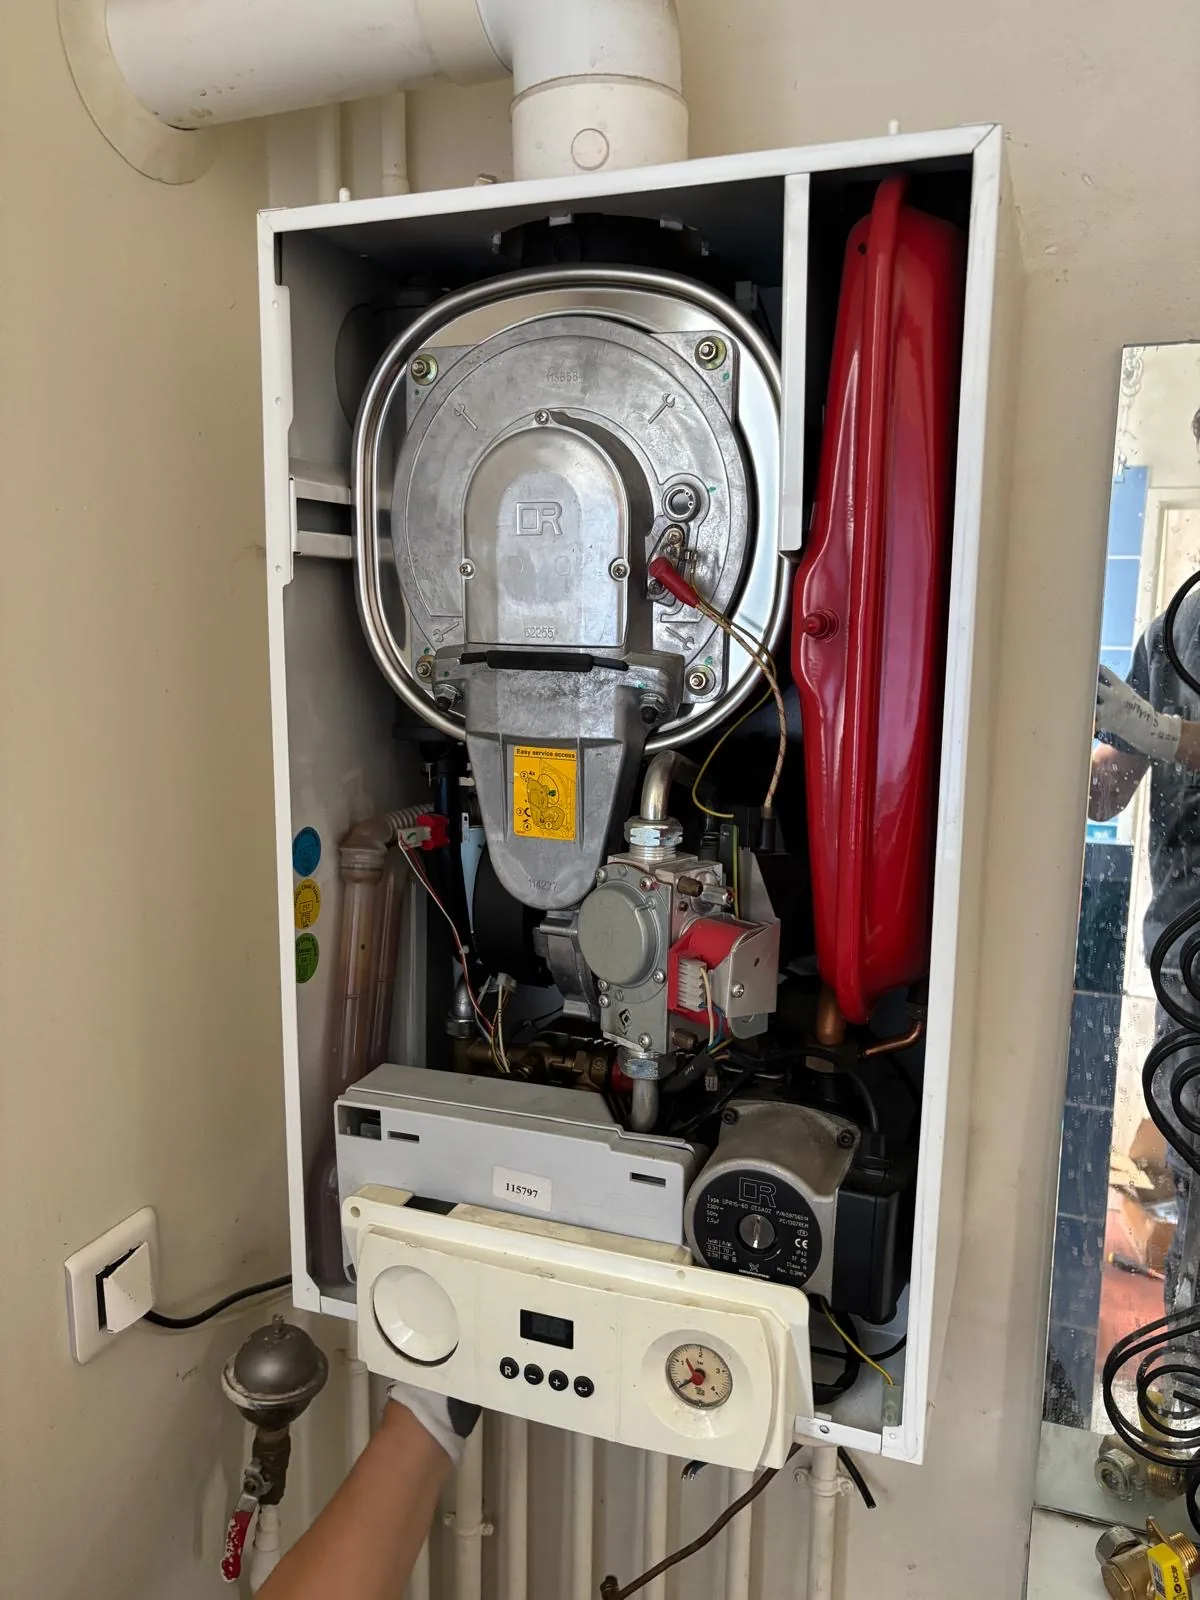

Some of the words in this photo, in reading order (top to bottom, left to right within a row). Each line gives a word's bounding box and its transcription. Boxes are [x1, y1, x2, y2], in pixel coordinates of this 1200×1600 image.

[516, 748, 531, 756] Easy
[531, 750, 553, 758] service
[505, 1182, 539, 1198] 115797
[794, 1238, 809, 1250] CE
[504, 1365, 512, 1376] R
